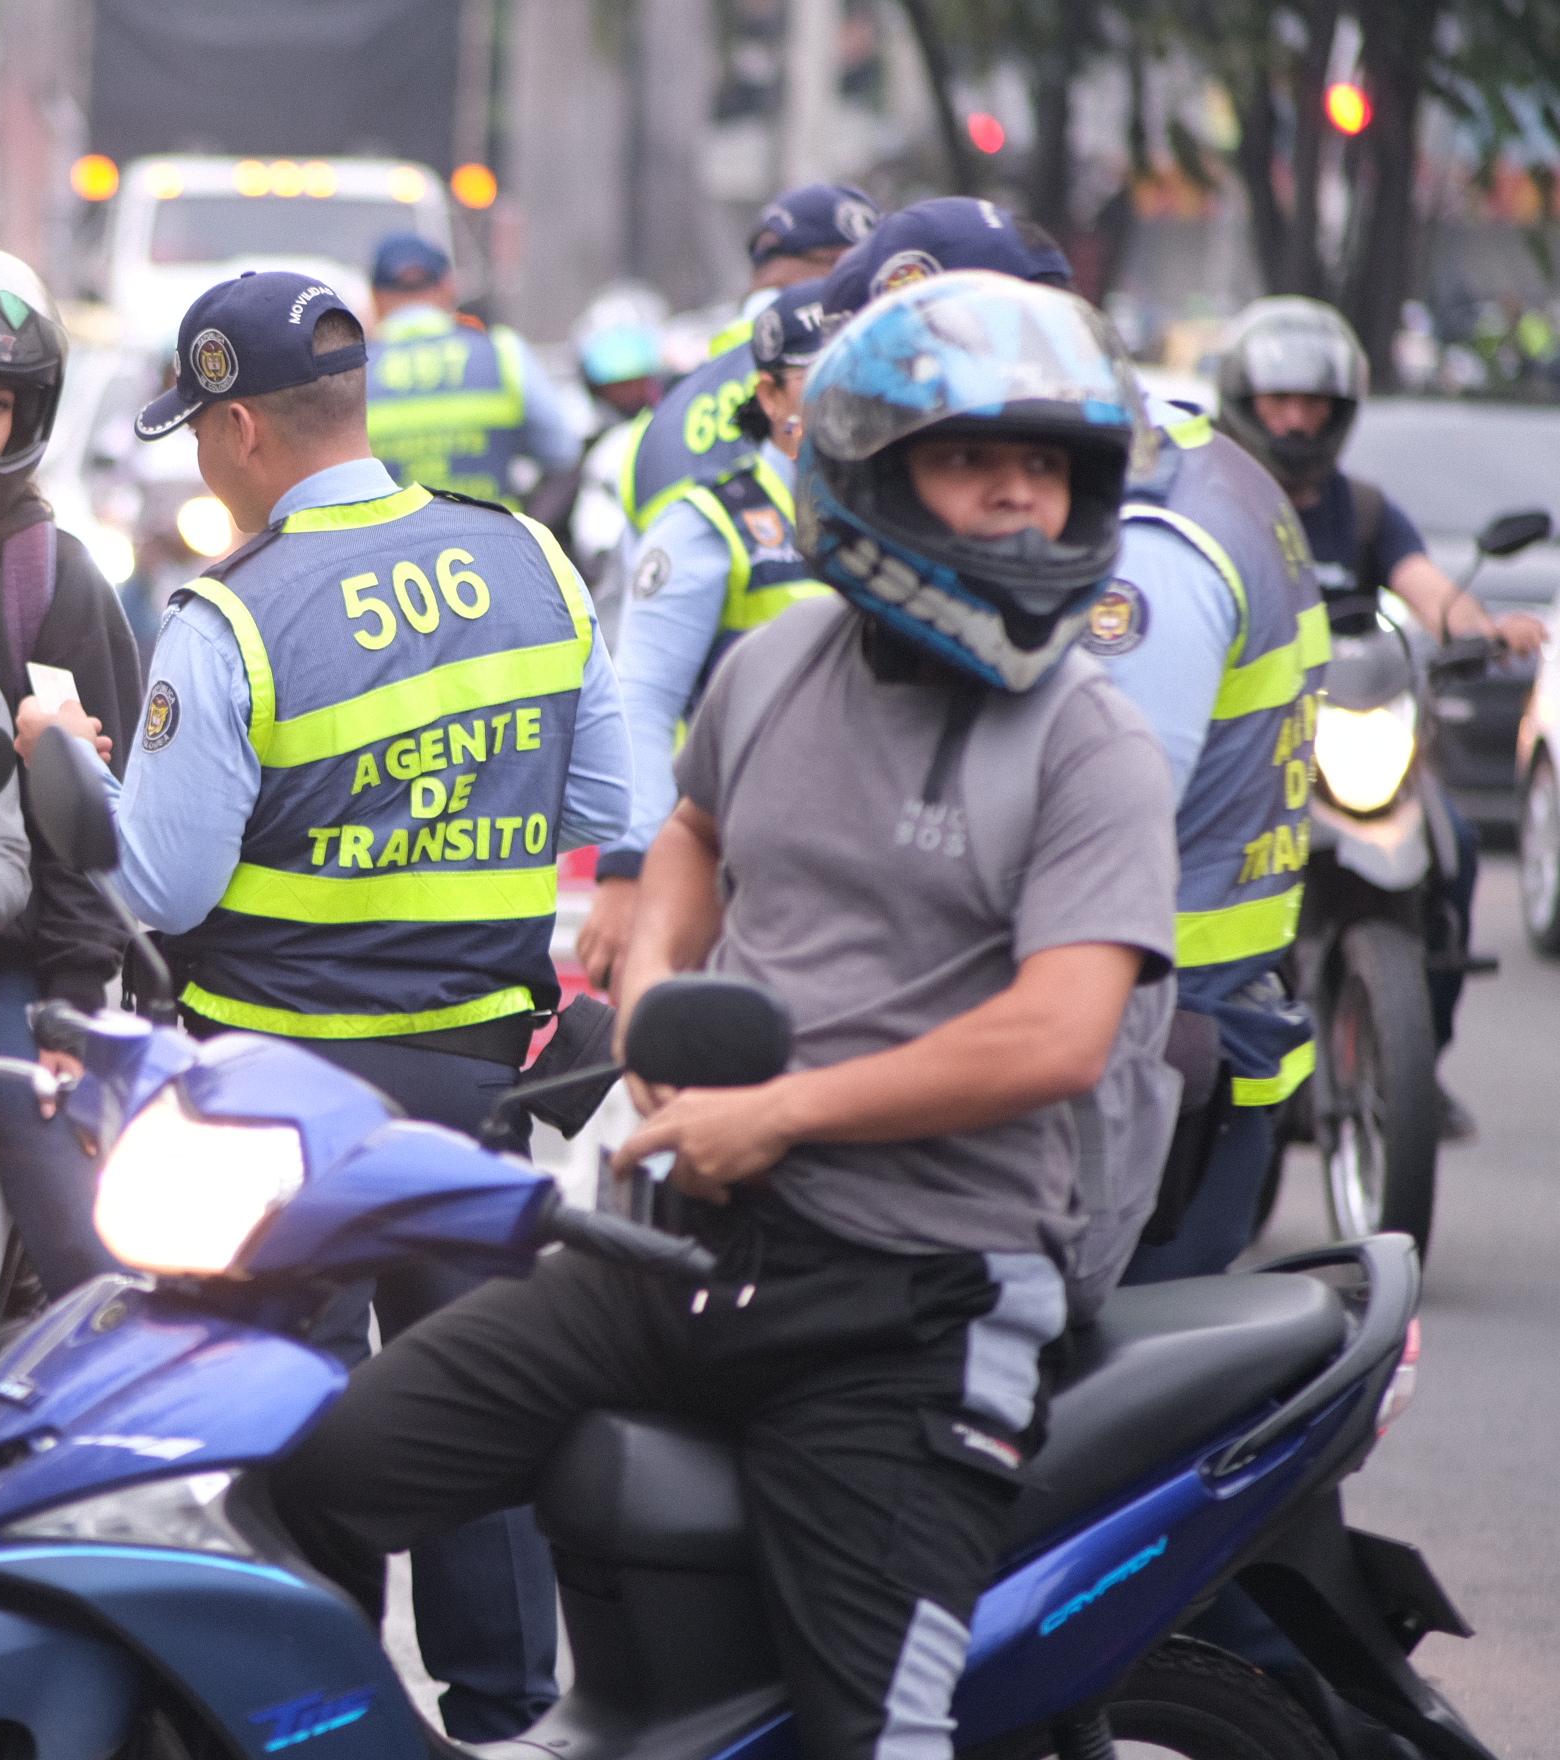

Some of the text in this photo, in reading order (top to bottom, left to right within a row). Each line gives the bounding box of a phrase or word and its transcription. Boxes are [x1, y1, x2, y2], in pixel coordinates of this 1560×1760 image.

[341, 548, 491, 651] 506
[351, 708, 542, 795] AGENTE
[411, 773, 477, 819] DE
[308, 813, 548, 869] TRANSITO
